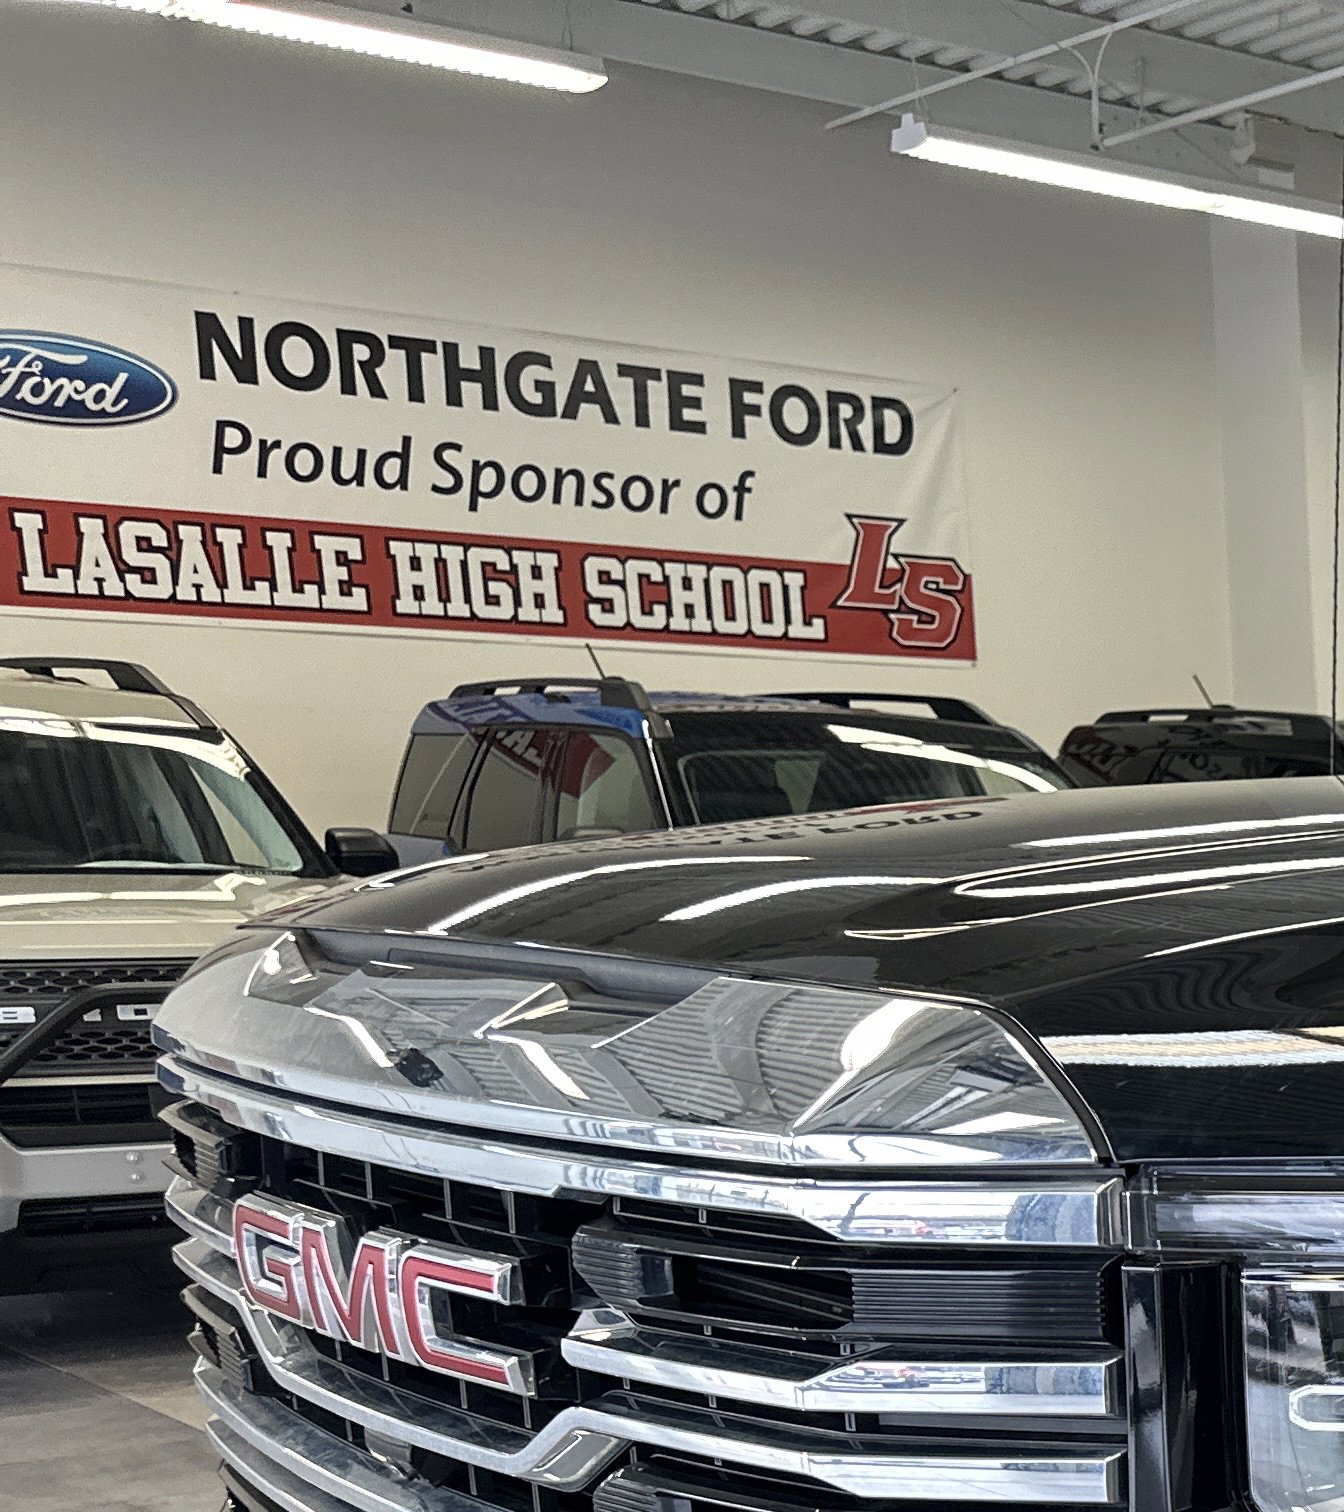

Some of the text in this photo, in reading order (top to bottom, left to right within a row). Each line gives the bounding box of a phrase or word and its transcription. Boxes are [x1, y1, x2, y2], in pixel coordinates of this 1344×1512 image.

[0, 342, 130, 414] Ford
[193, 309, 915, 456] NORTHGATE FORD
[211, 418, 756, 522] Proud Sponsor of
[9, 509, 826, 641] LASALLE HIGH SCHOOL
[834, 513, 967, 649] LS
[233, 1193, 538, 1399] GMC
